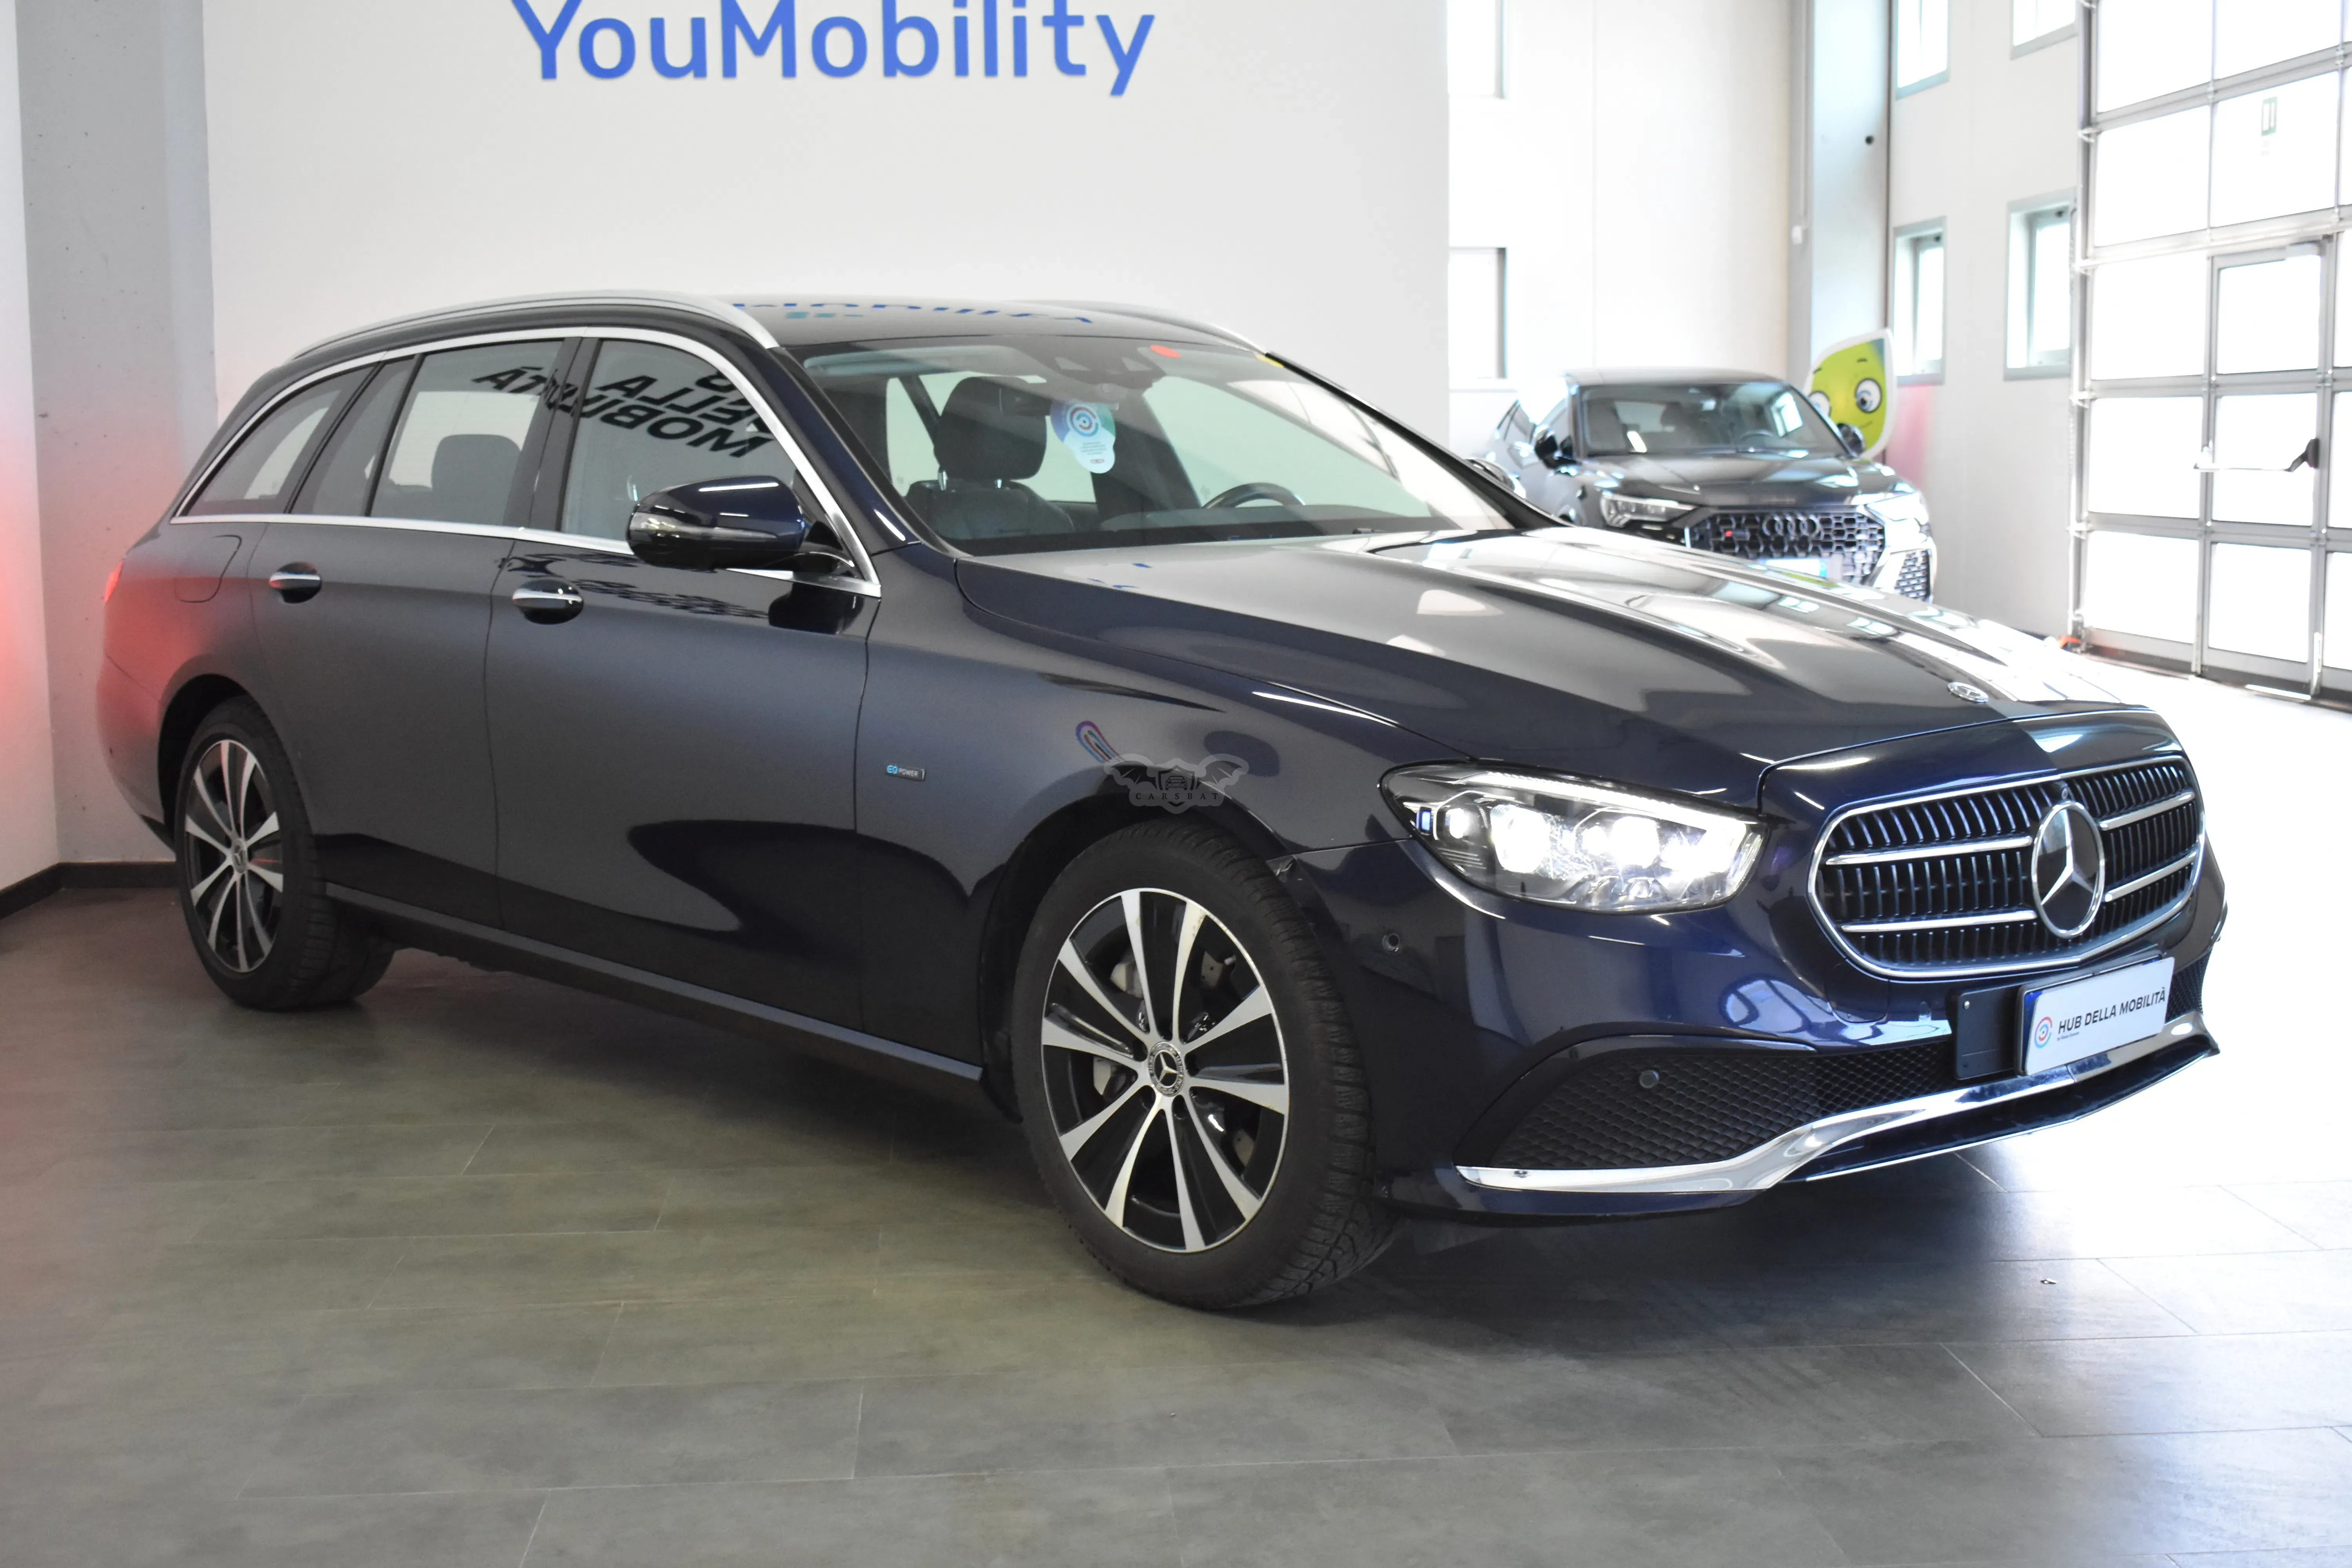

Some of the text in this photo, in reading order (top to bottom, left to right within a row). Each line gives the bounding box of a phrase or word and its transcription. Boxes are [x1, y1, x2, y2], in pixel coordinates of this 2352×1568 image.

[512, 0, 1155, 96] YouMobility
[887, 765, 919, 777] EQ POWER
[2058, 986, 2165, 1034] HUB DELLA MOBILITÀ
